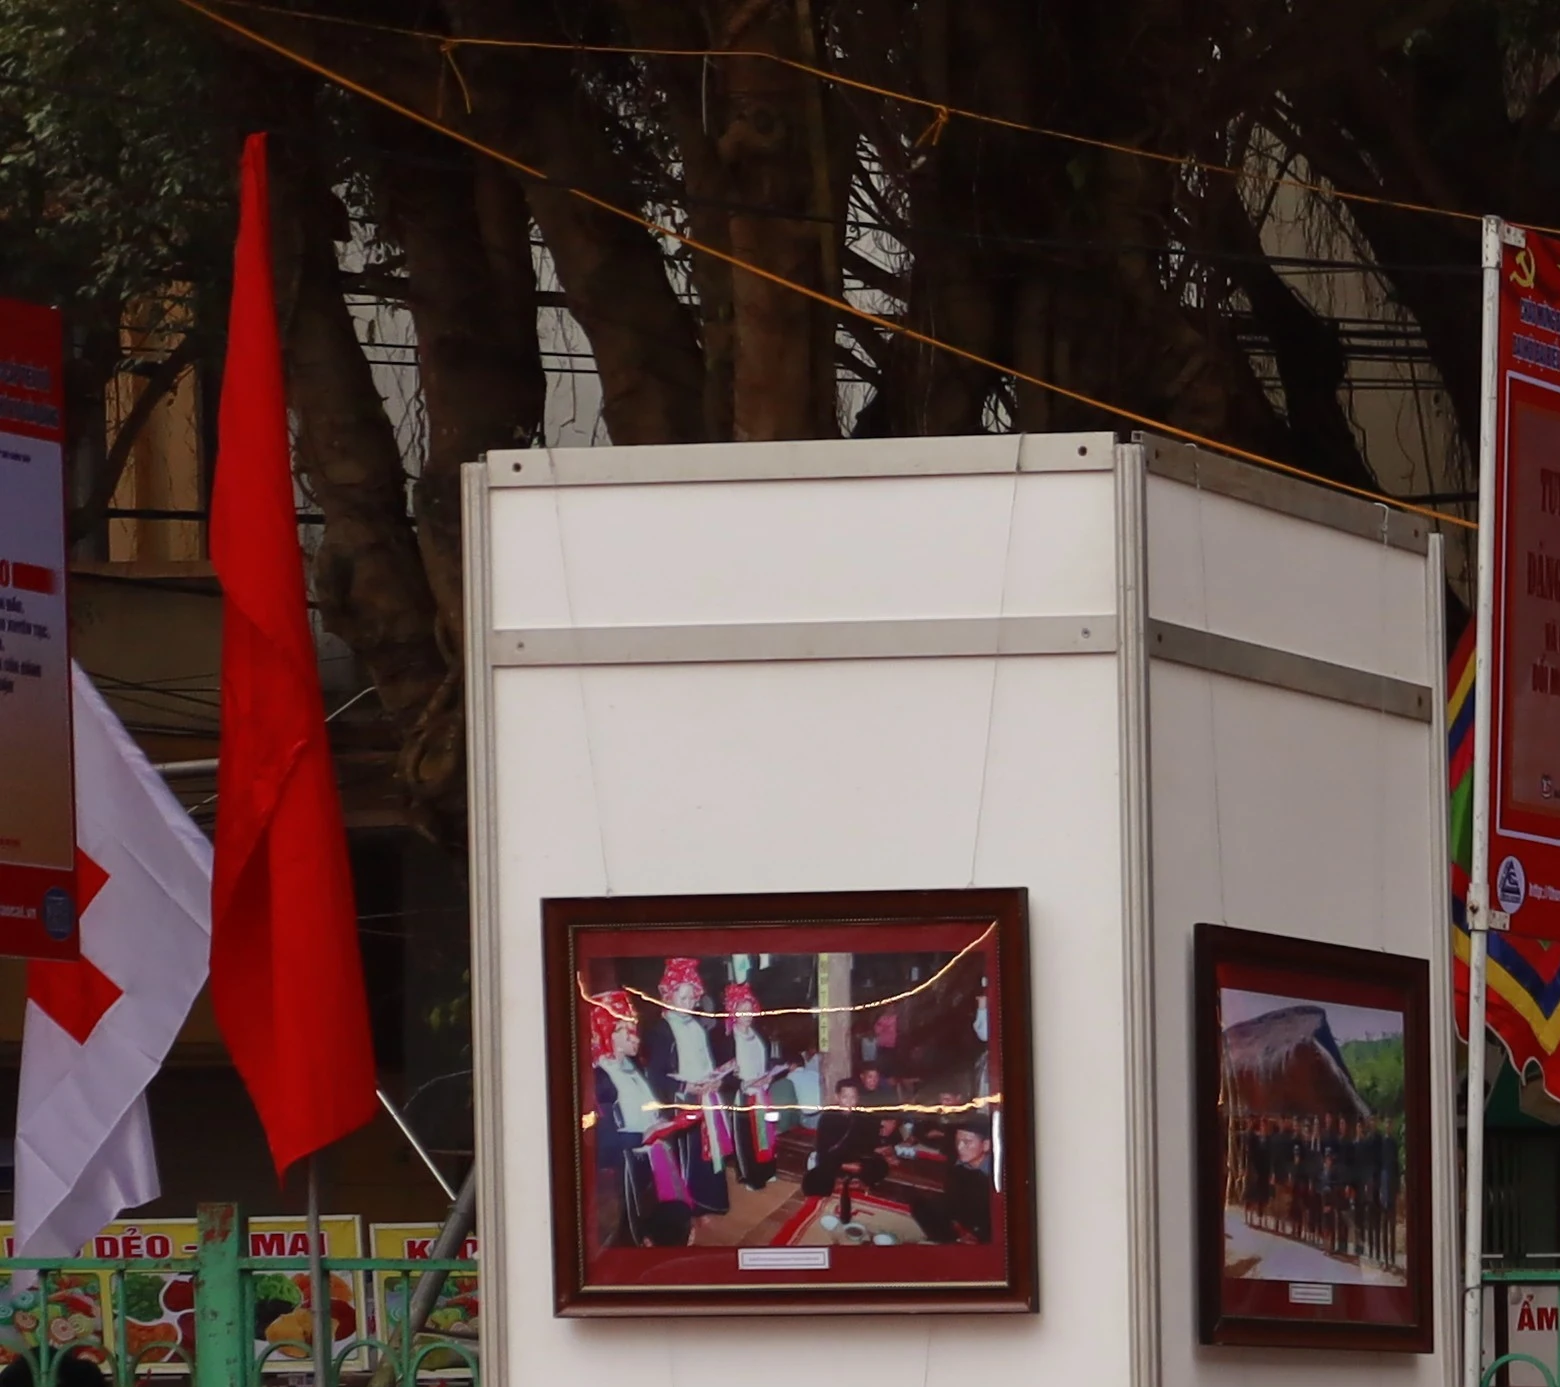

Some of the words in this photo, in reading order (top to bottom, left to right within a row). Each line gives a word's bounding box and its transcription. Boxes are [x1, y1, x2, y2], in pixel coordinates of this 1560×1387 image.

[94, 1227, 171, 1259] DẺO
[251, 1232, 326, 1258] MAI
[1517, 1294, 1559, 1331] ẨM
